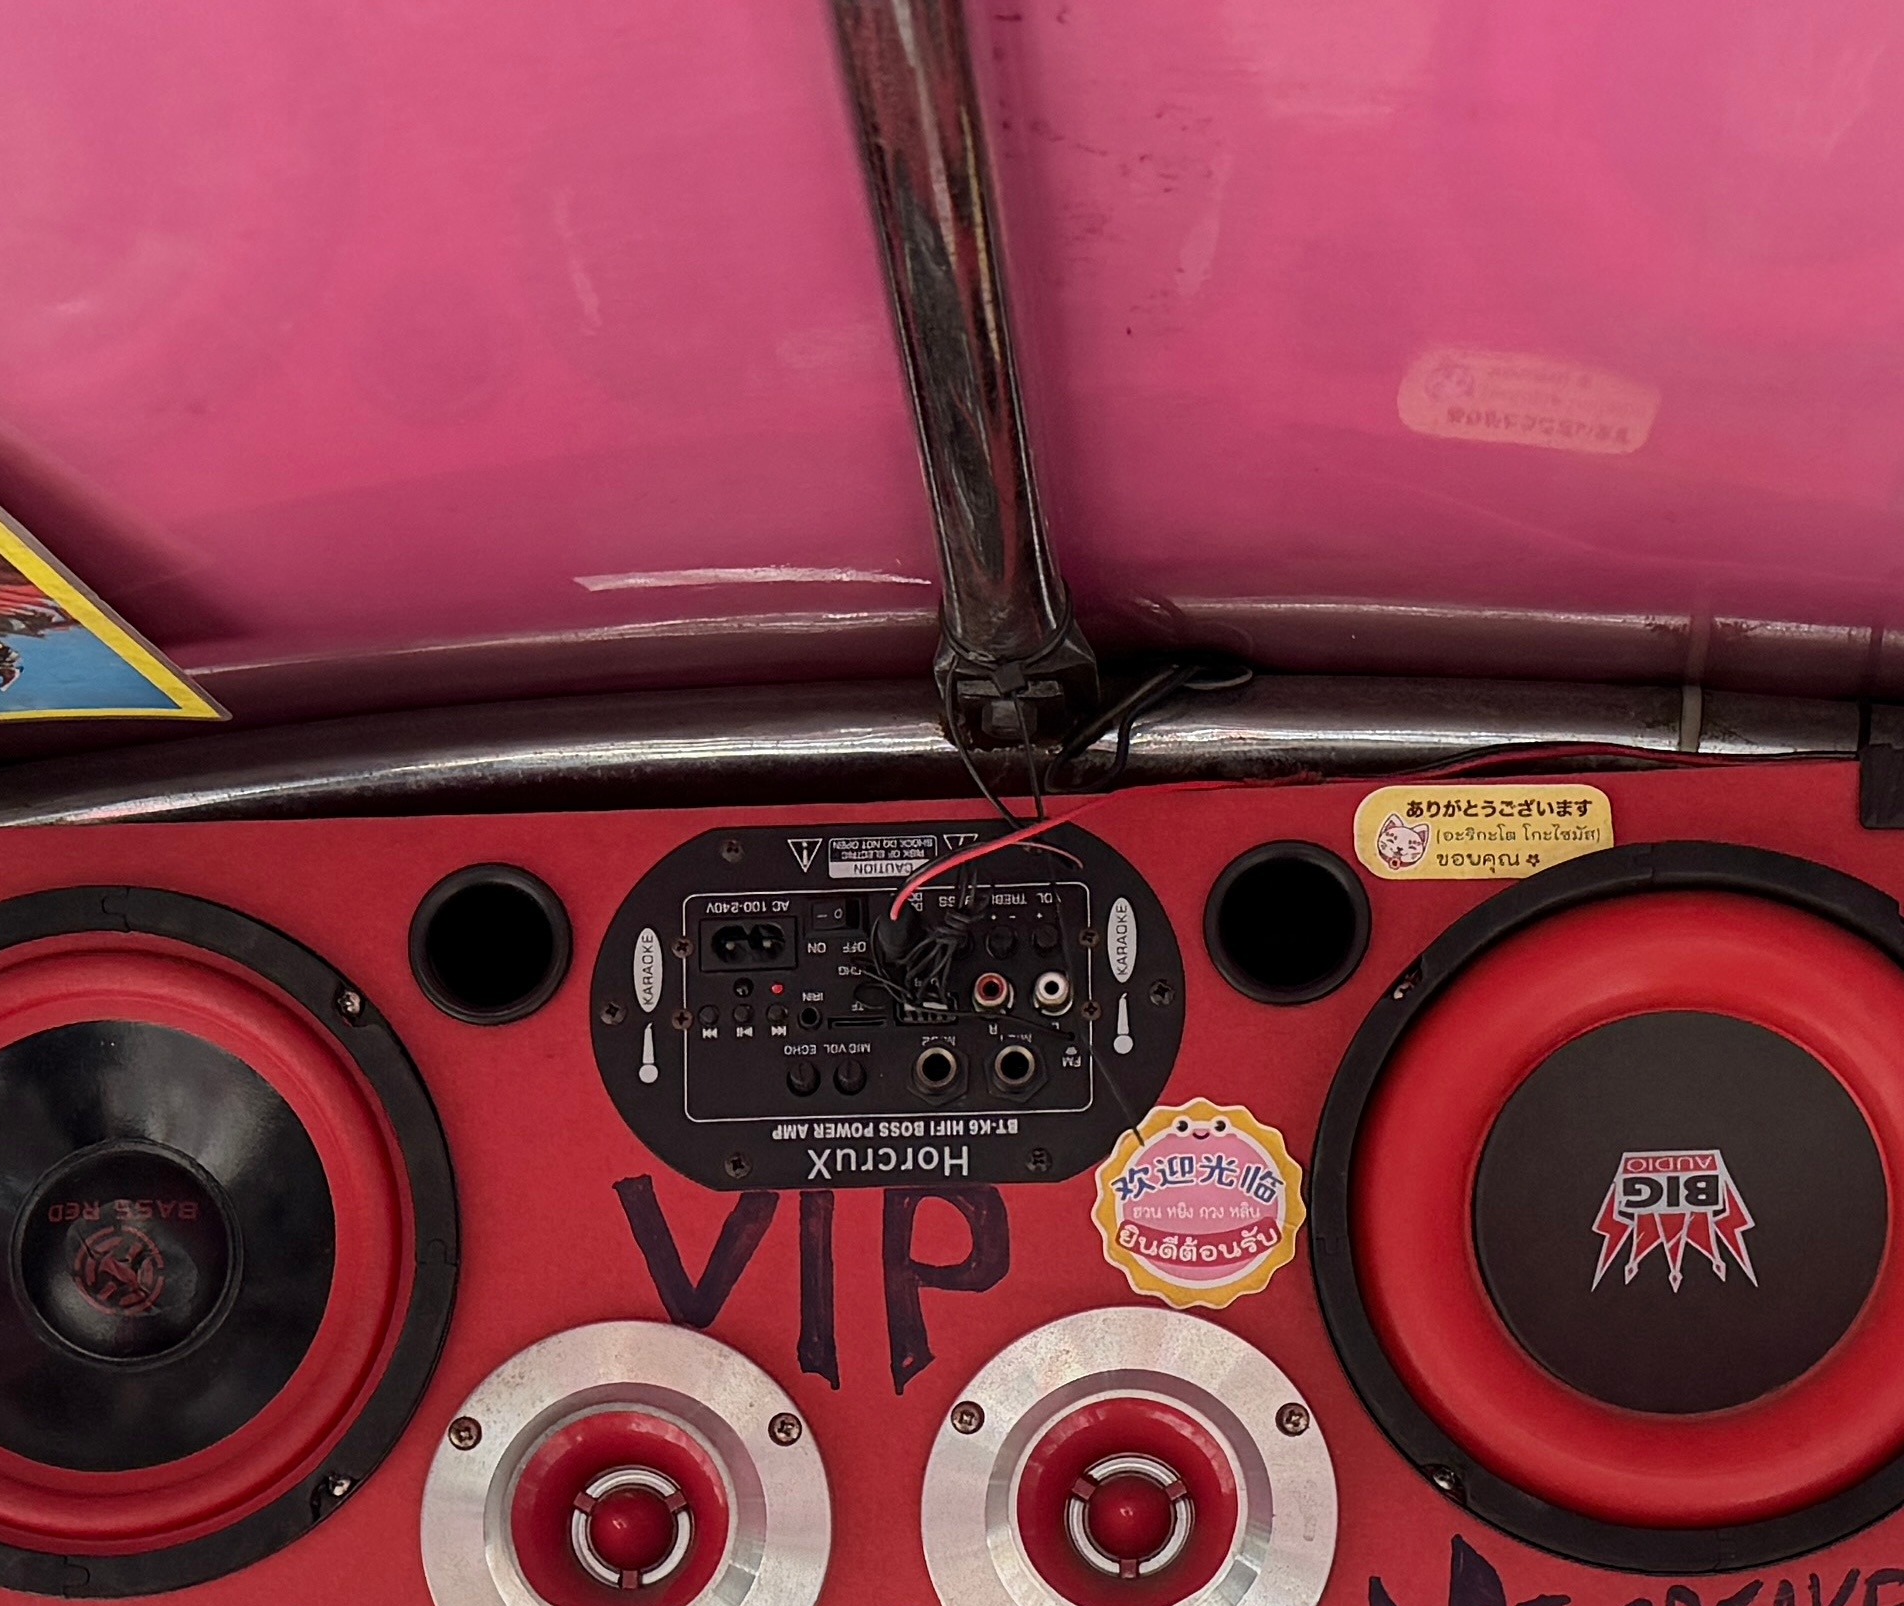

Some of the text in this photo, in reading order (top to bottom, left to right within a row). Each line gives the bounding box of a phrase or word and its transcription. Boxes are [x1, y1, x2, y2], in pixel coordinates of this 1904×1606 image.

[1406, 799, 1592, 818] ありがとうございます
[832, 841, 860, 850] OPEN
[863, 840, 880, 848] NOT
[853, 862, 913, 876] CAUTION
[1436, 852, 1521, 873] ขอบคุณ
[706, 901, 790, 913] AC 100-240V
[807, 943, 827, 954] ON
[842, 942, 867, 953] OFF
[1117, 904, 1127, 976] KARAOKE
[642, 934, 654, 1007] KARAOKE
[784, 1044, 817, 1055] ECHO
[1061, 1056, 1081, 1067] FM
[772, 1119, 1018, 1140] BT-K6 HIFI BOSS POWER AMP
[1626, 1156, 1713, 1172] AUDIO
[1111, 1155, 1284, 1203] 欢迎光临
[1623, 1174, 1720, 1208] BIG
[48, 1200, 198, 1223] BASS RED
[1119, 1224, 1278, 1261] ยินดีต้อนรับ
[612, 1174, 1010, 1396] VIP
